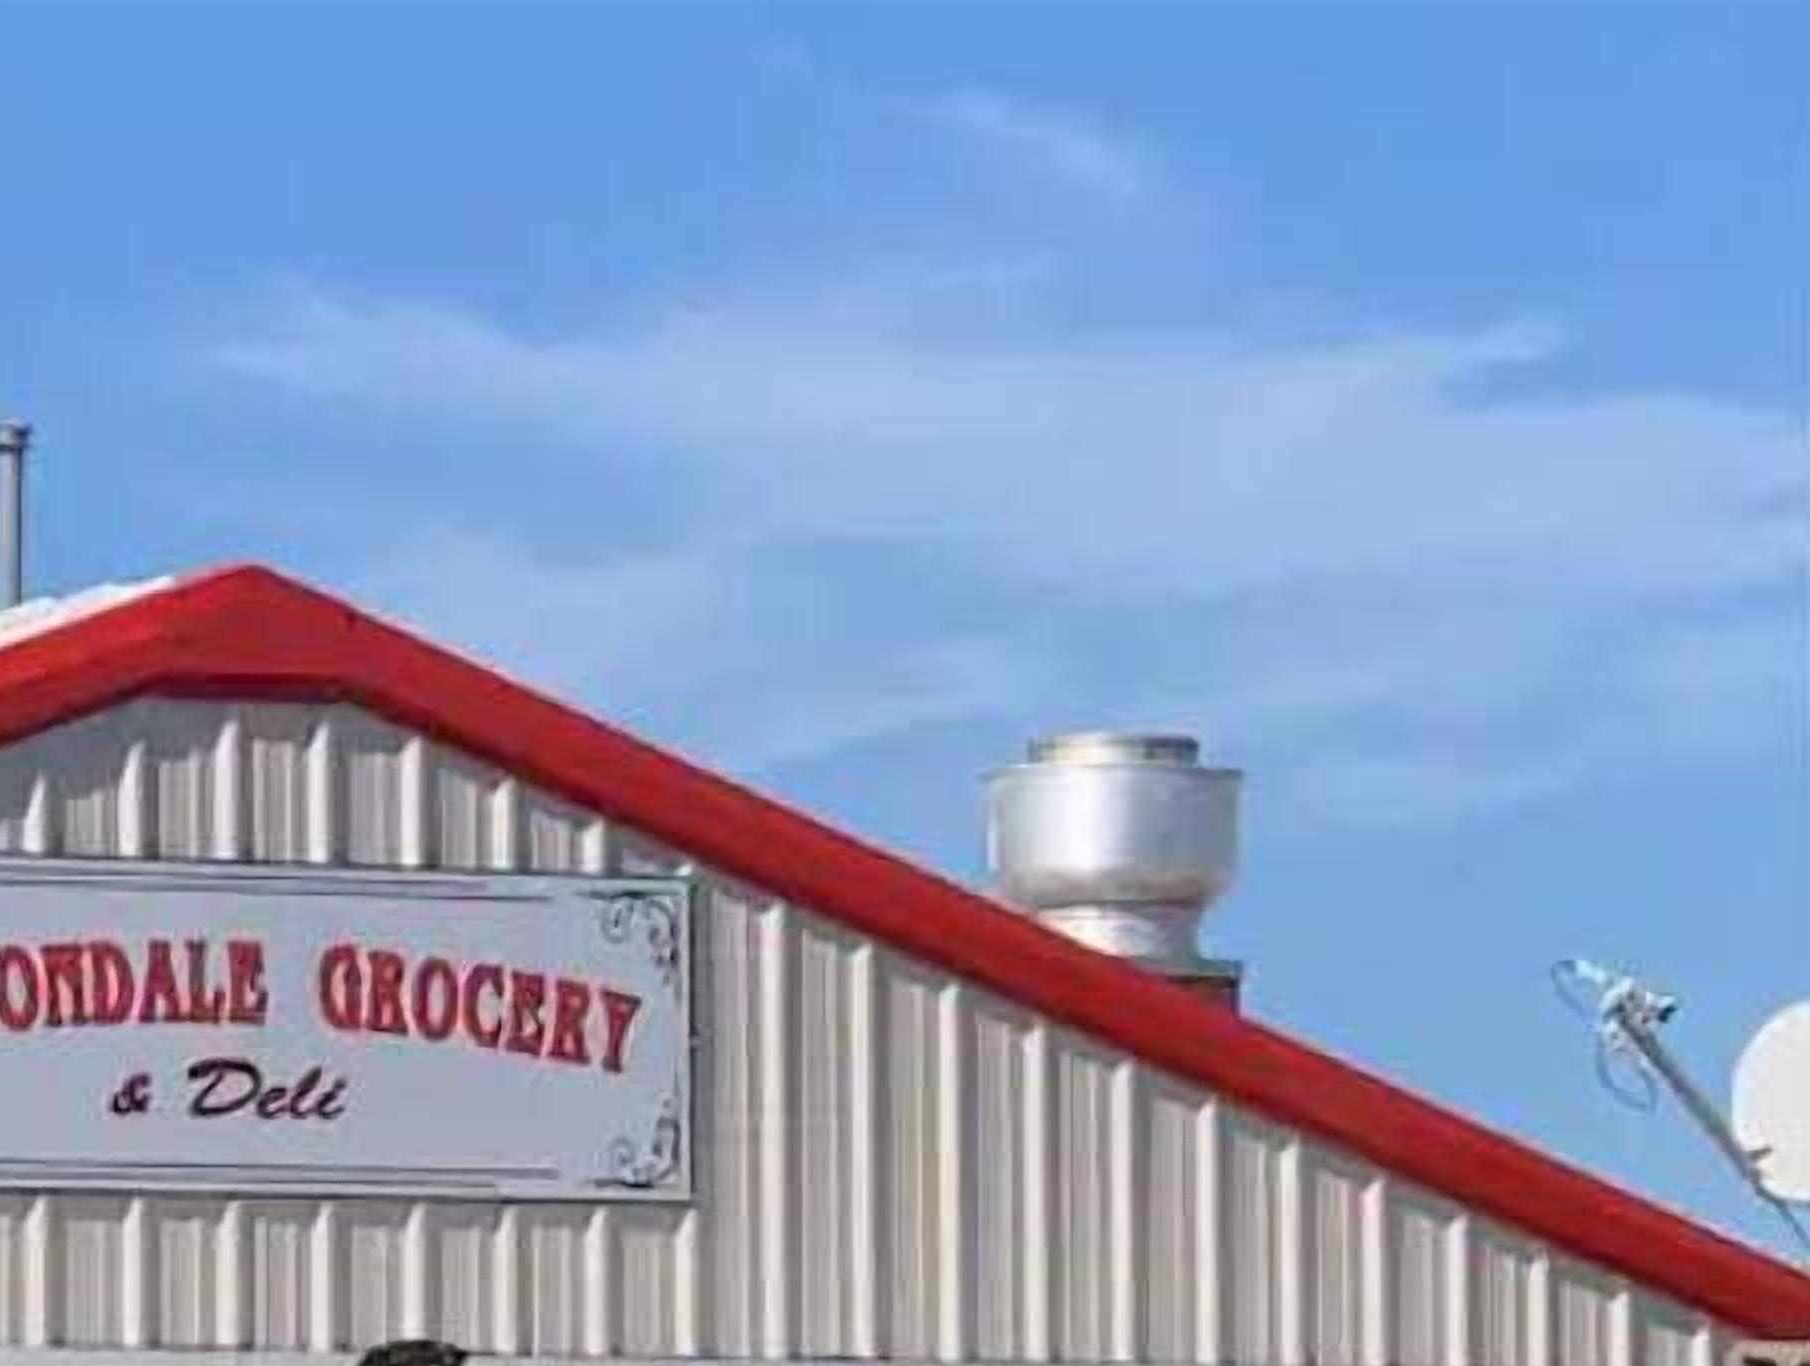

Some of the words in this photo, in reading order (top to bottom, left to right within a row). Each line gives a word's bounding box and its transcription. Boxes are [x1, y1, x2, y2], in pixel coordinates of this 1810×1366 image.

[319, 943, 642, 1074] GROCERY
[110, 1074, 152, 1116] &
[186, 1058, 348, 1121] Deli
